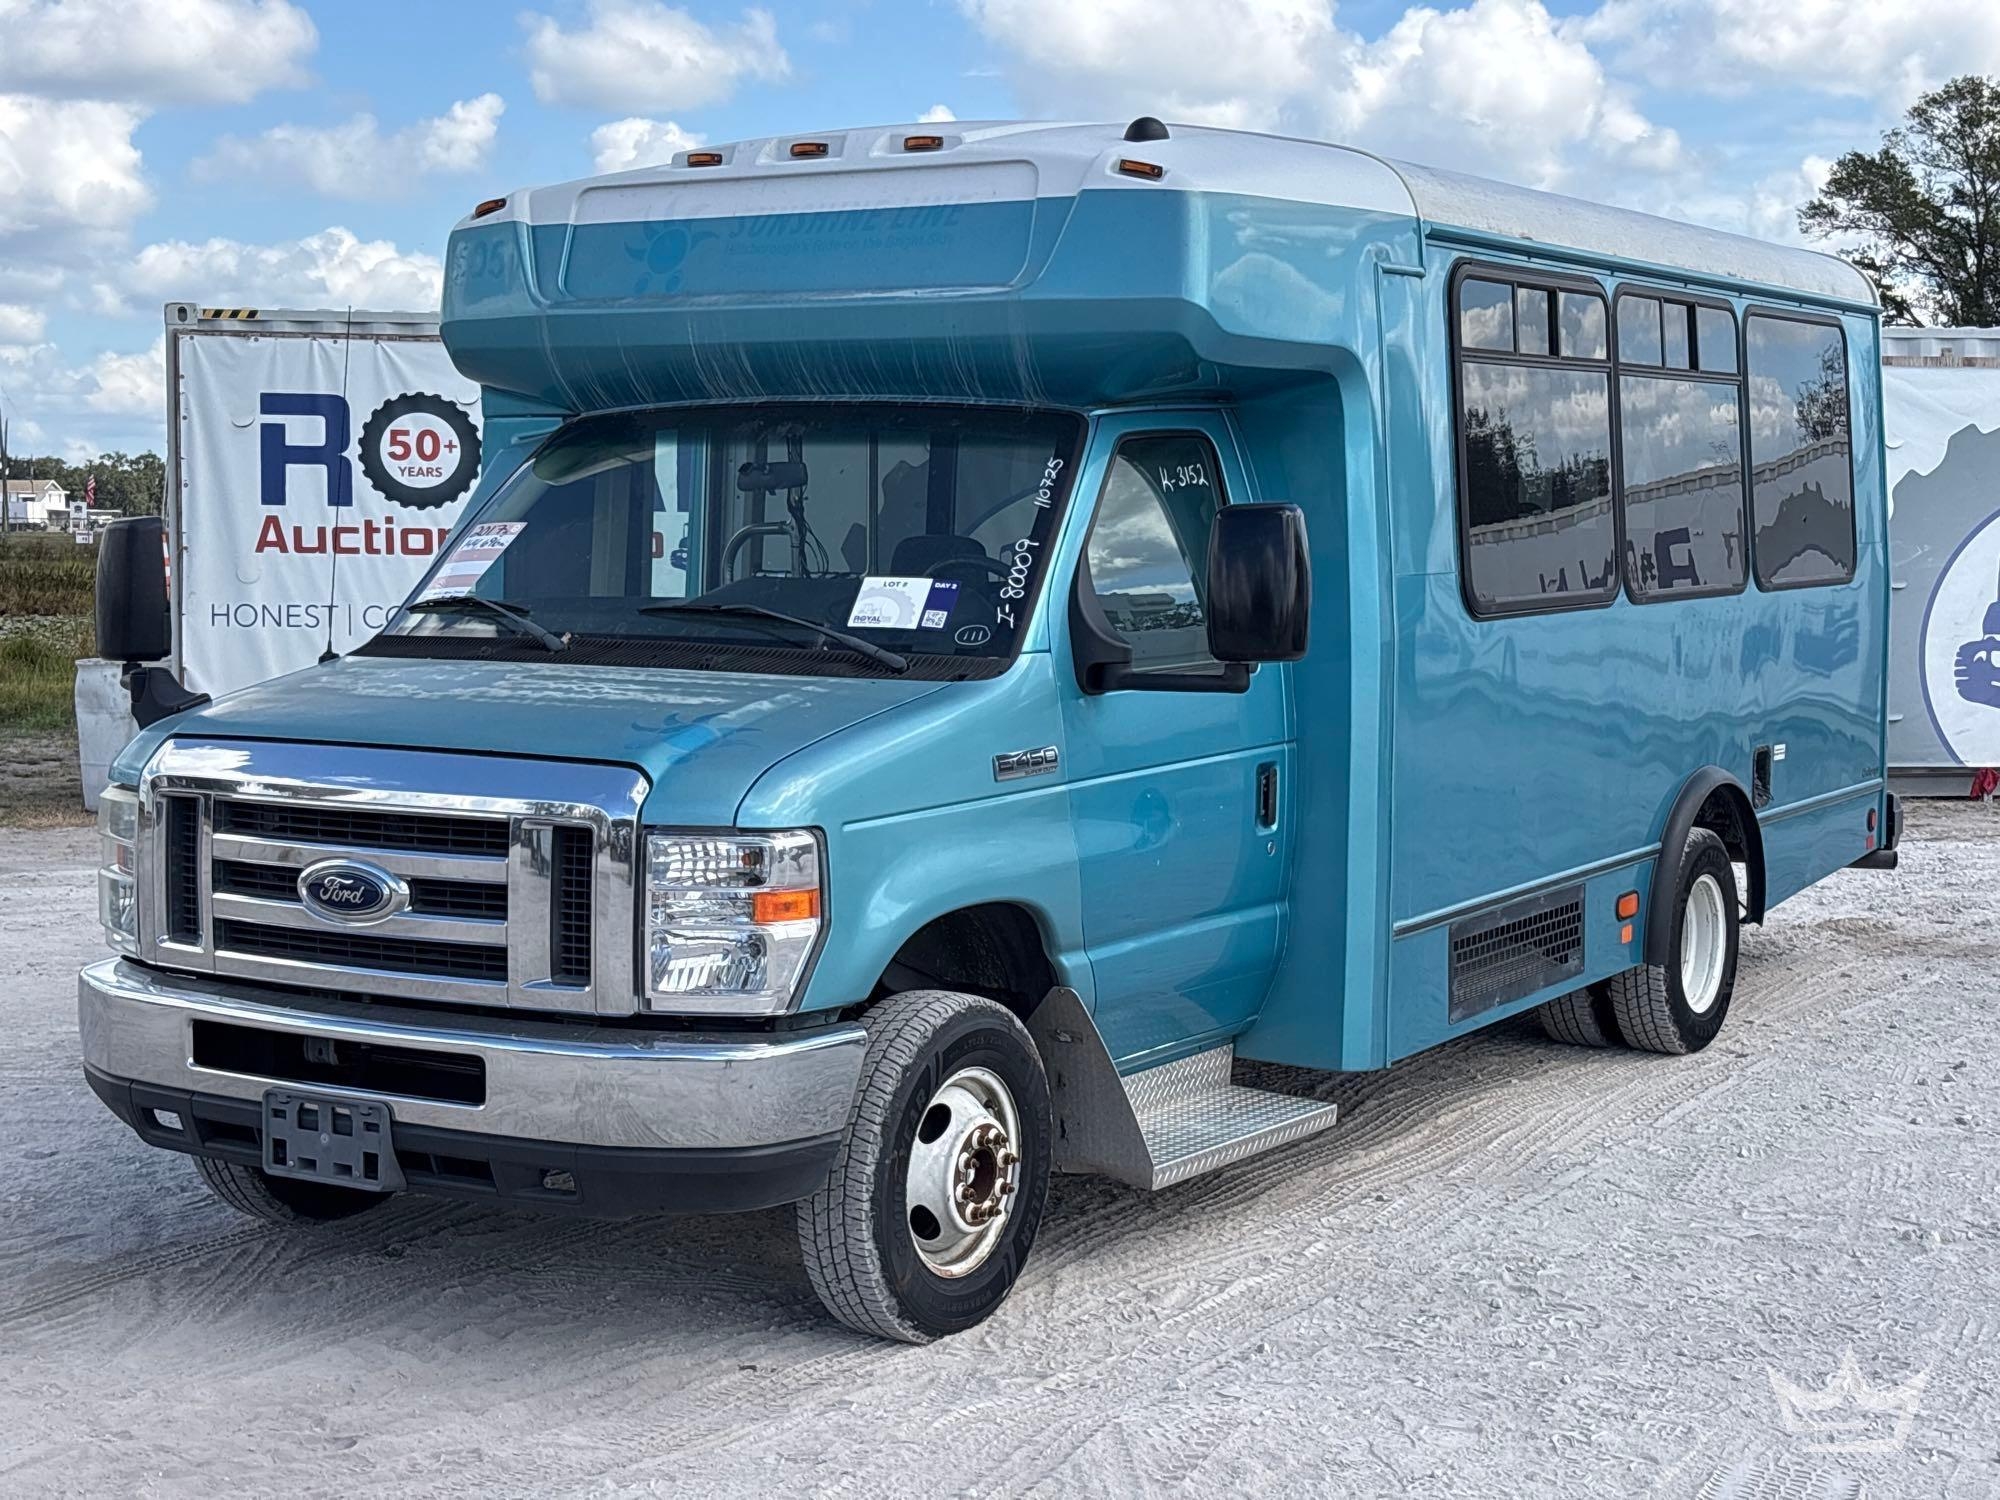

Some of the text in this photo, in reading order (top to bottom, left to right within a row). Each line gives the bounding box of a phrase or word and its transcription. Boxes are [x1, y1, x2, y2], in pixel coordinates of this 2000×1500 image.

[387, 429, 458, 462] 50+
[398, 466, 443, 478] YEARS
[1033, 457, 1064, 508] 110725
[1158, 464, 1210, 493] K-3152
[255, 514, 453, 556] Auctio
[211, 603, 339, 628] HONEST
[319, 876, 366, 904] Ford
